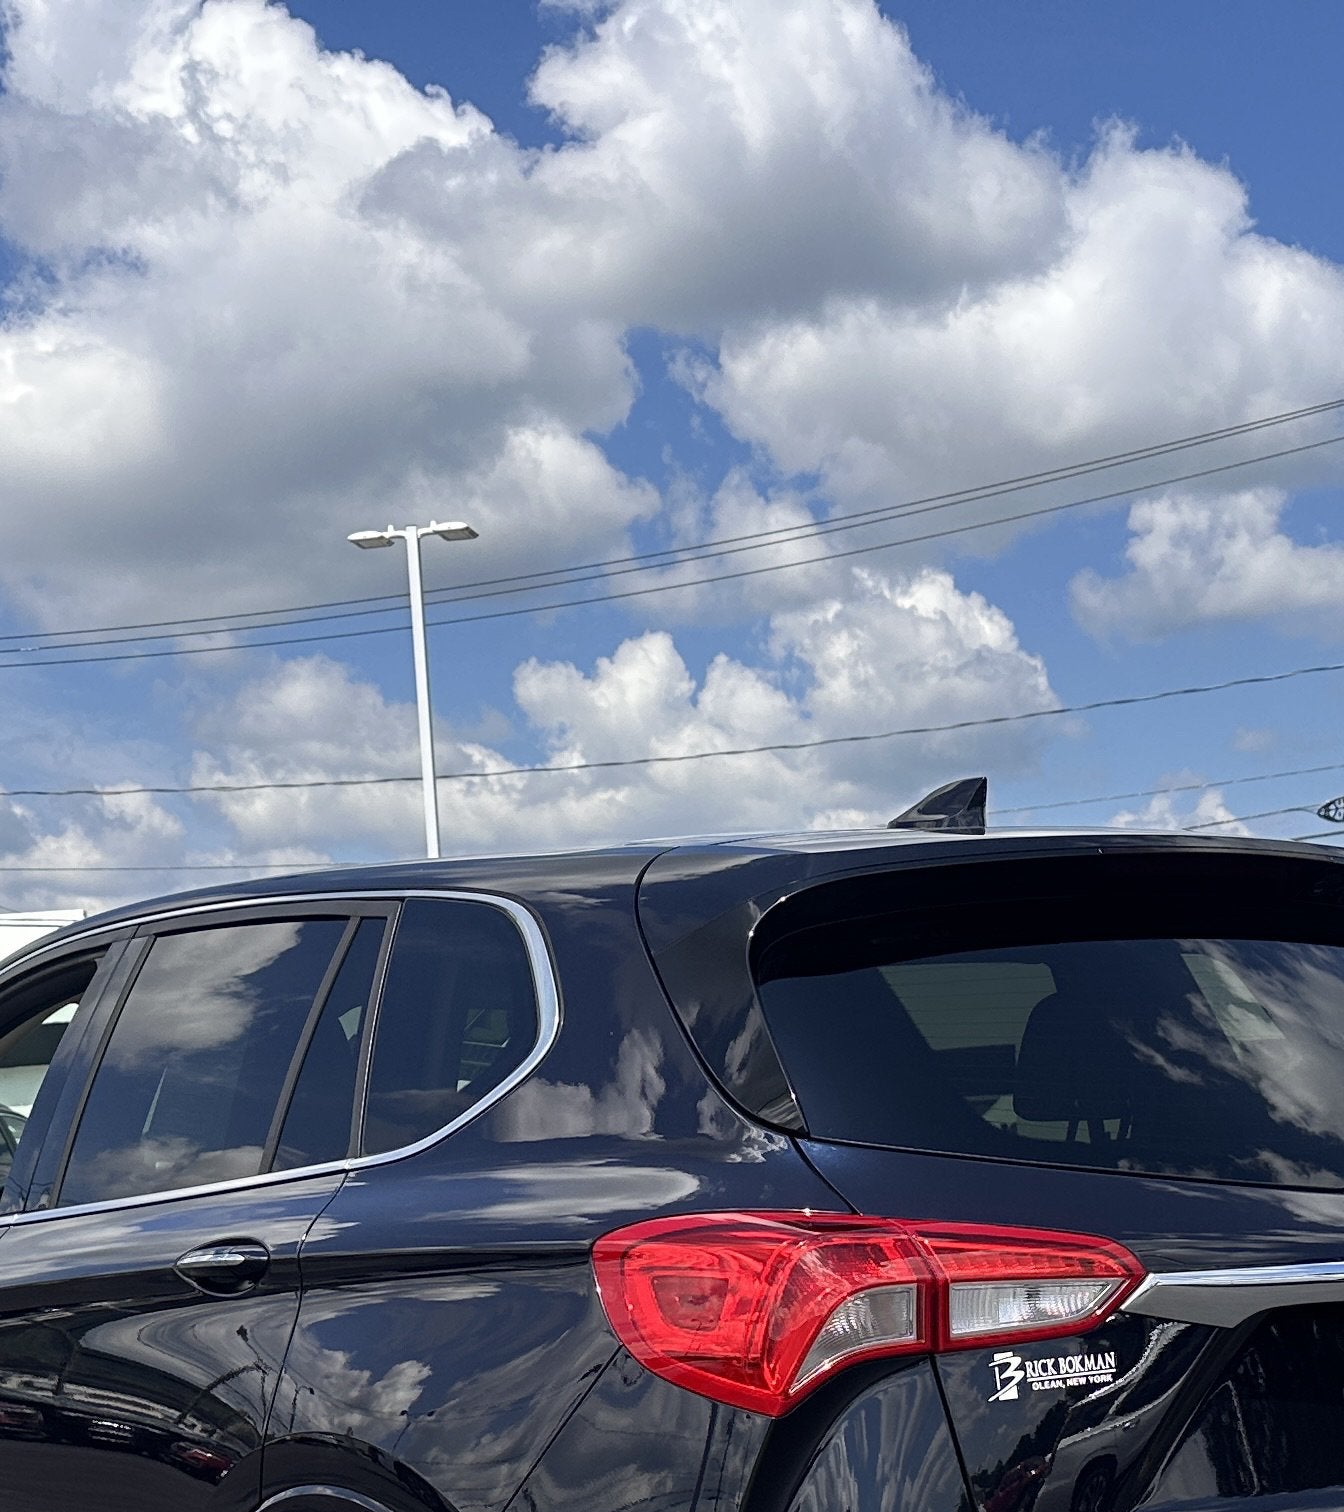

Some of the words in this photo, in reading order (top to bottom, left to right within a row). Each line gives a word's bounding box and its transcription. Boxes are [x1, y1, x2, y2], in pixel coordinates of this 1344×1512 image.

[1059, 1351, 1116, 1375] BOKMAN
[1067, 1376, 1087, 1387] NEW
[1088, 1373, 1113, 1385] YORK
